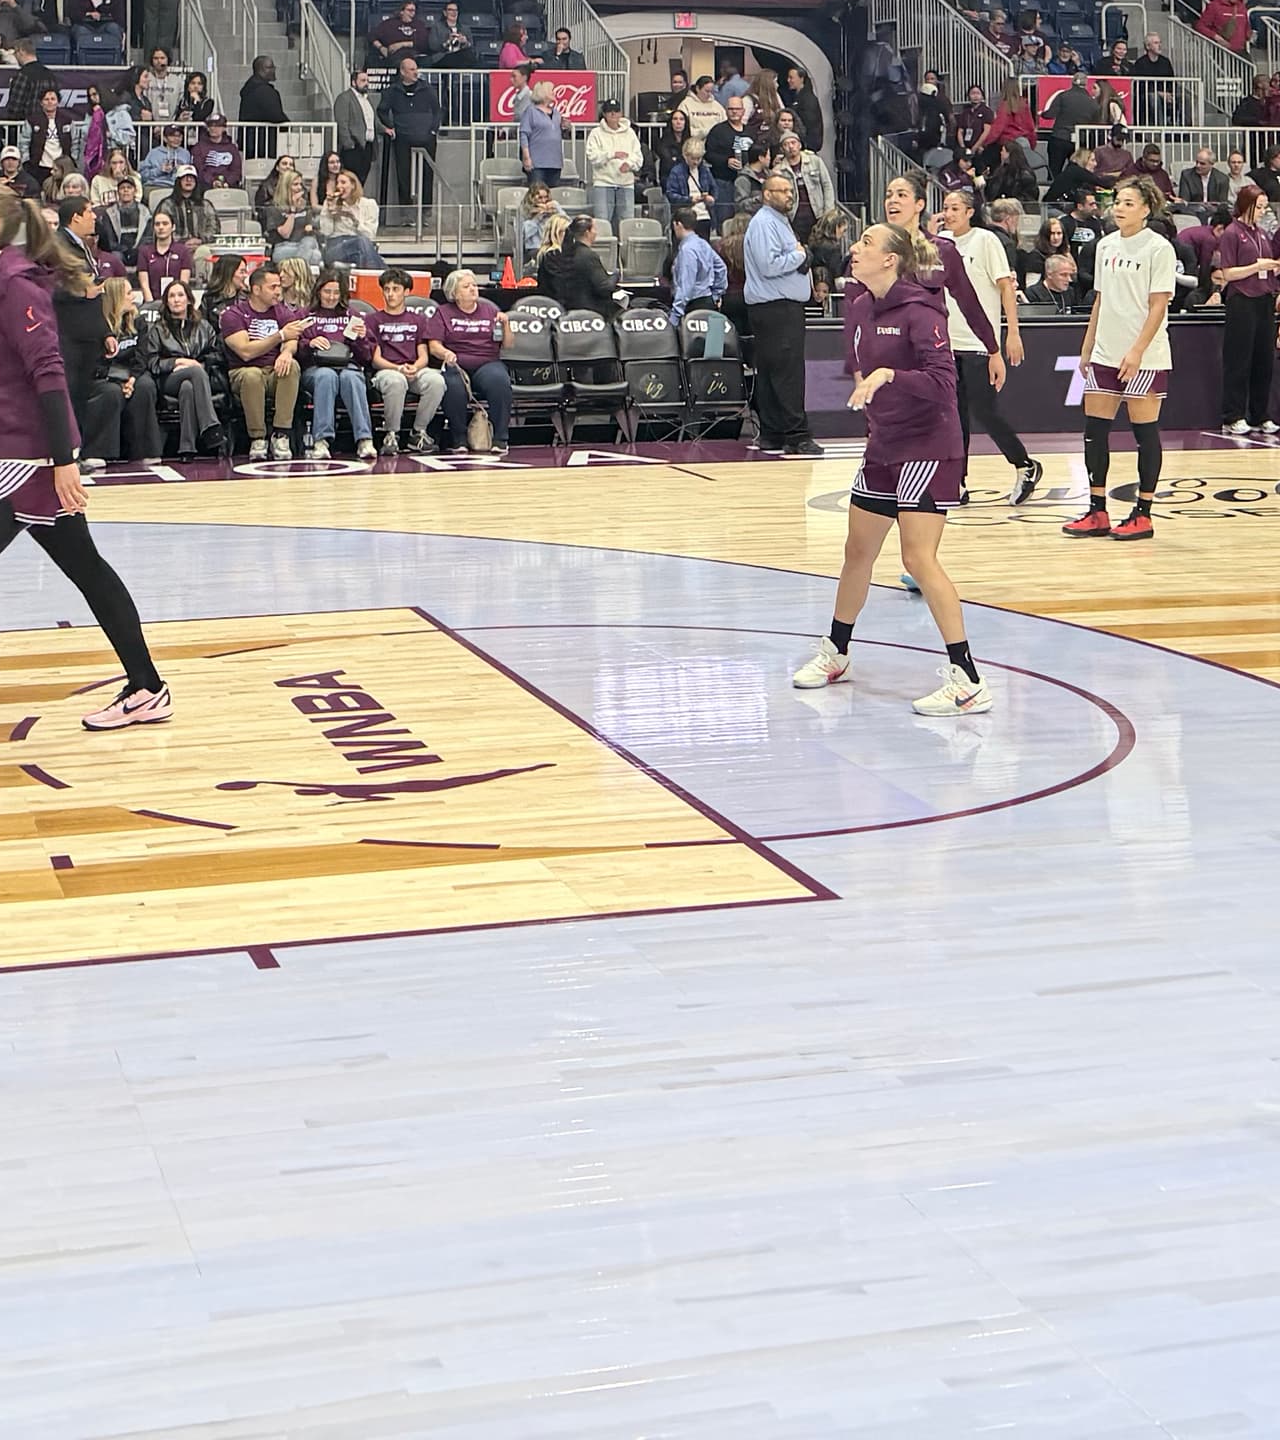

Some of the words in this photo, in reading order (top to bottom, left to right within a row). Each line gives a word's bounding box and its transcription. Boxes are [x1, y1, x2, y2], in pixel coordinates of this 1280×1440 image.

[560, 319, 591, 333] CIBC
[622, 317, 654, 332] CIBC
[686, 318, 709, 332] CIB
[273, 669, 445, 775] WNBA
